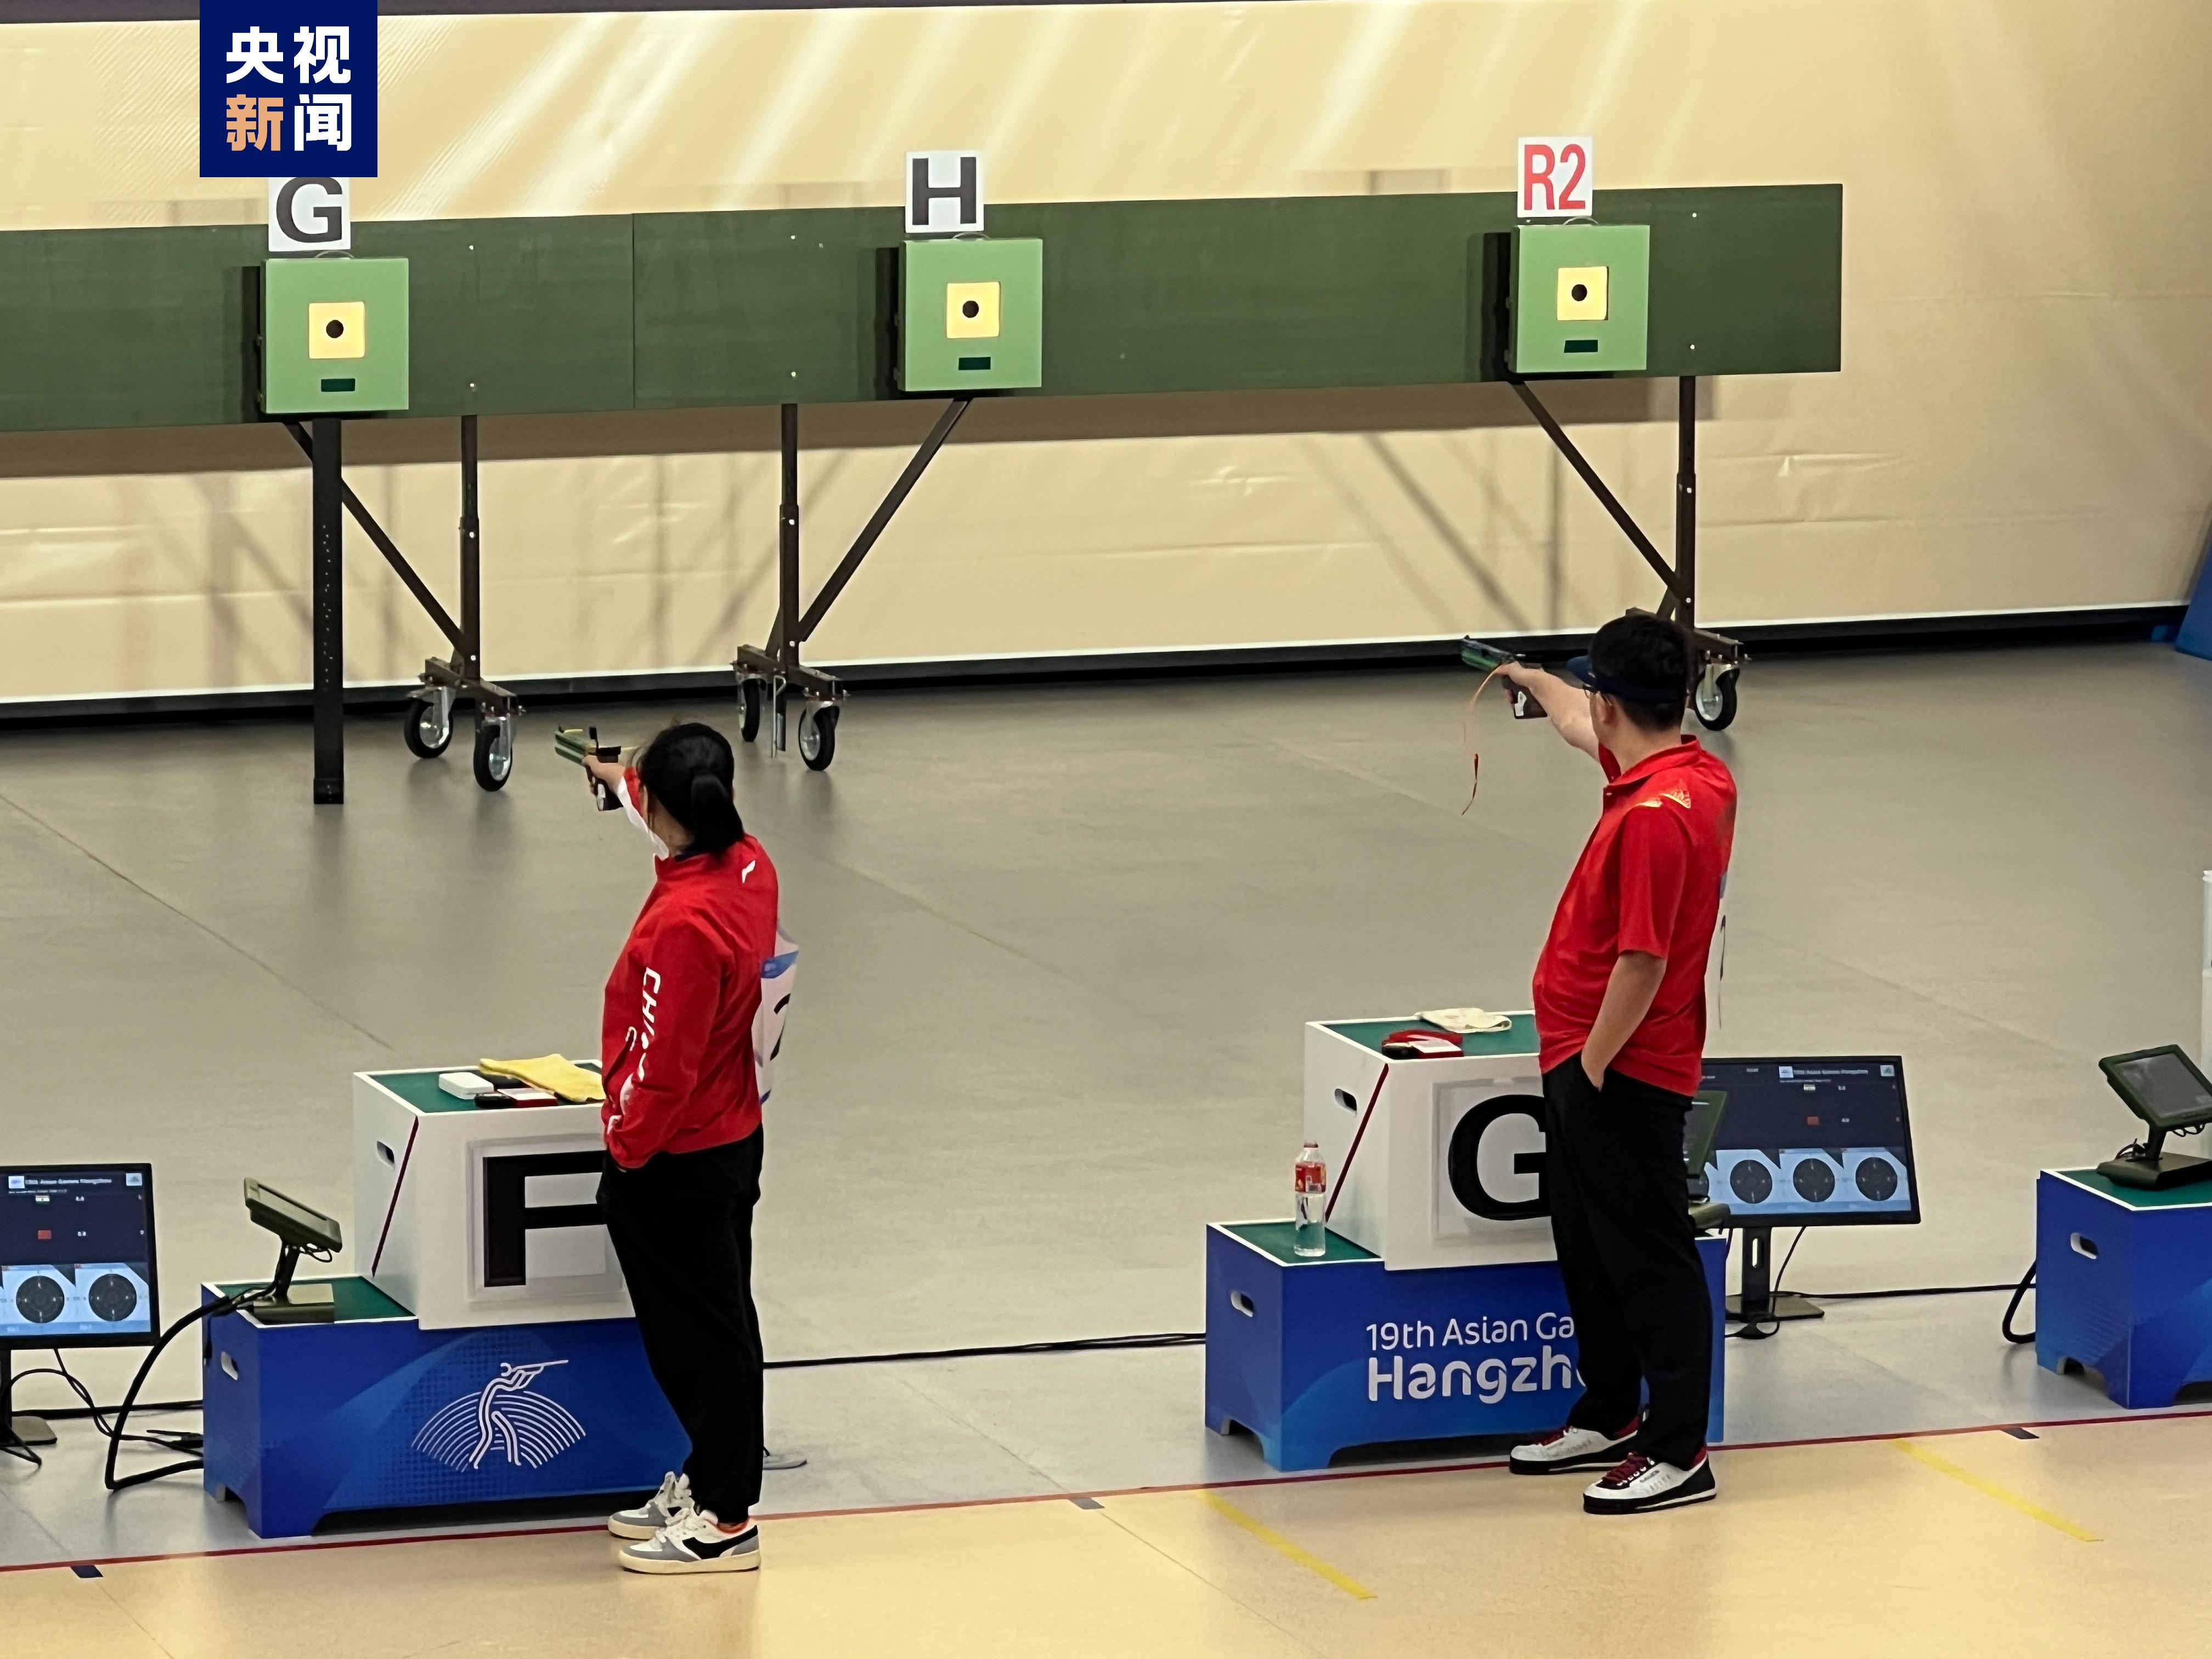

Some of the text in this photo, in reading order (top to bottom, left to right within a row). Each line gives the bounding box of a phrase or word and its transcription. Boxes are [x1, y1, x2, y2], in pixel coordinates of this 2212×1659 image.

[275, 177, 343, 244] G
[912, 156, 977, 226] H
[1523, 143, 1586, 211] R2
[1447, 1094, 1551, 1221] G
[482, 1150, 607, 1288] F
[1365, 1321, 1435, 1351] 19th
[1442, 1316, 1528, 1346] Asian
[1368, 1345, 1587, 1404] Hangzh
